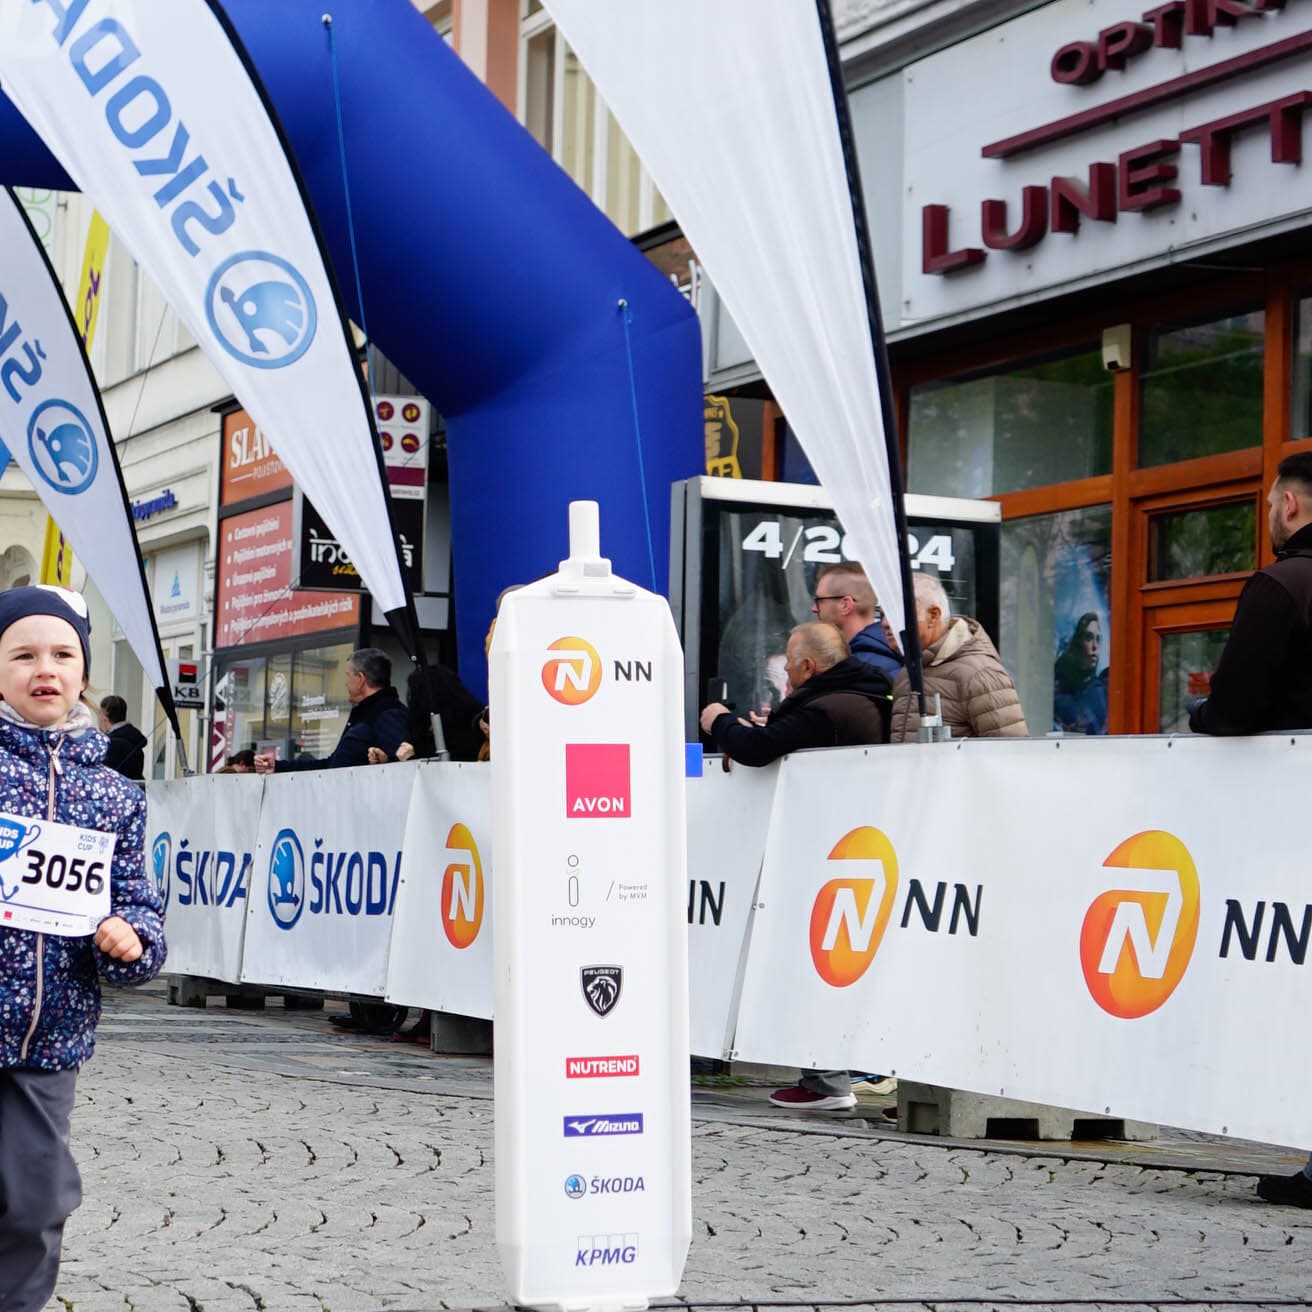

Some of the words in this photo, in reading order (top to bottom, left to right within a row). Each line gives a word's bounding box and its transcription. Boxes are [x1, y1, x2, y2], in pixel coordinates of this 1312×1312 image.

[613, 660, 652, 682] NN
[174, 686, 200, 699] KB
[572, 797, 624, 813] AVON
[21, 848, 105, 896] 3056
[899, 879, 984, 938] NN
[551, 914, 596, 929] innogy
[1218, 898, 1312, 965] NN
[569, 1059, 637, 1075] NUTREND
[590, 1176, 646, 1195] ŠKODA
[575, 1245, 637, 1267] KPMG
